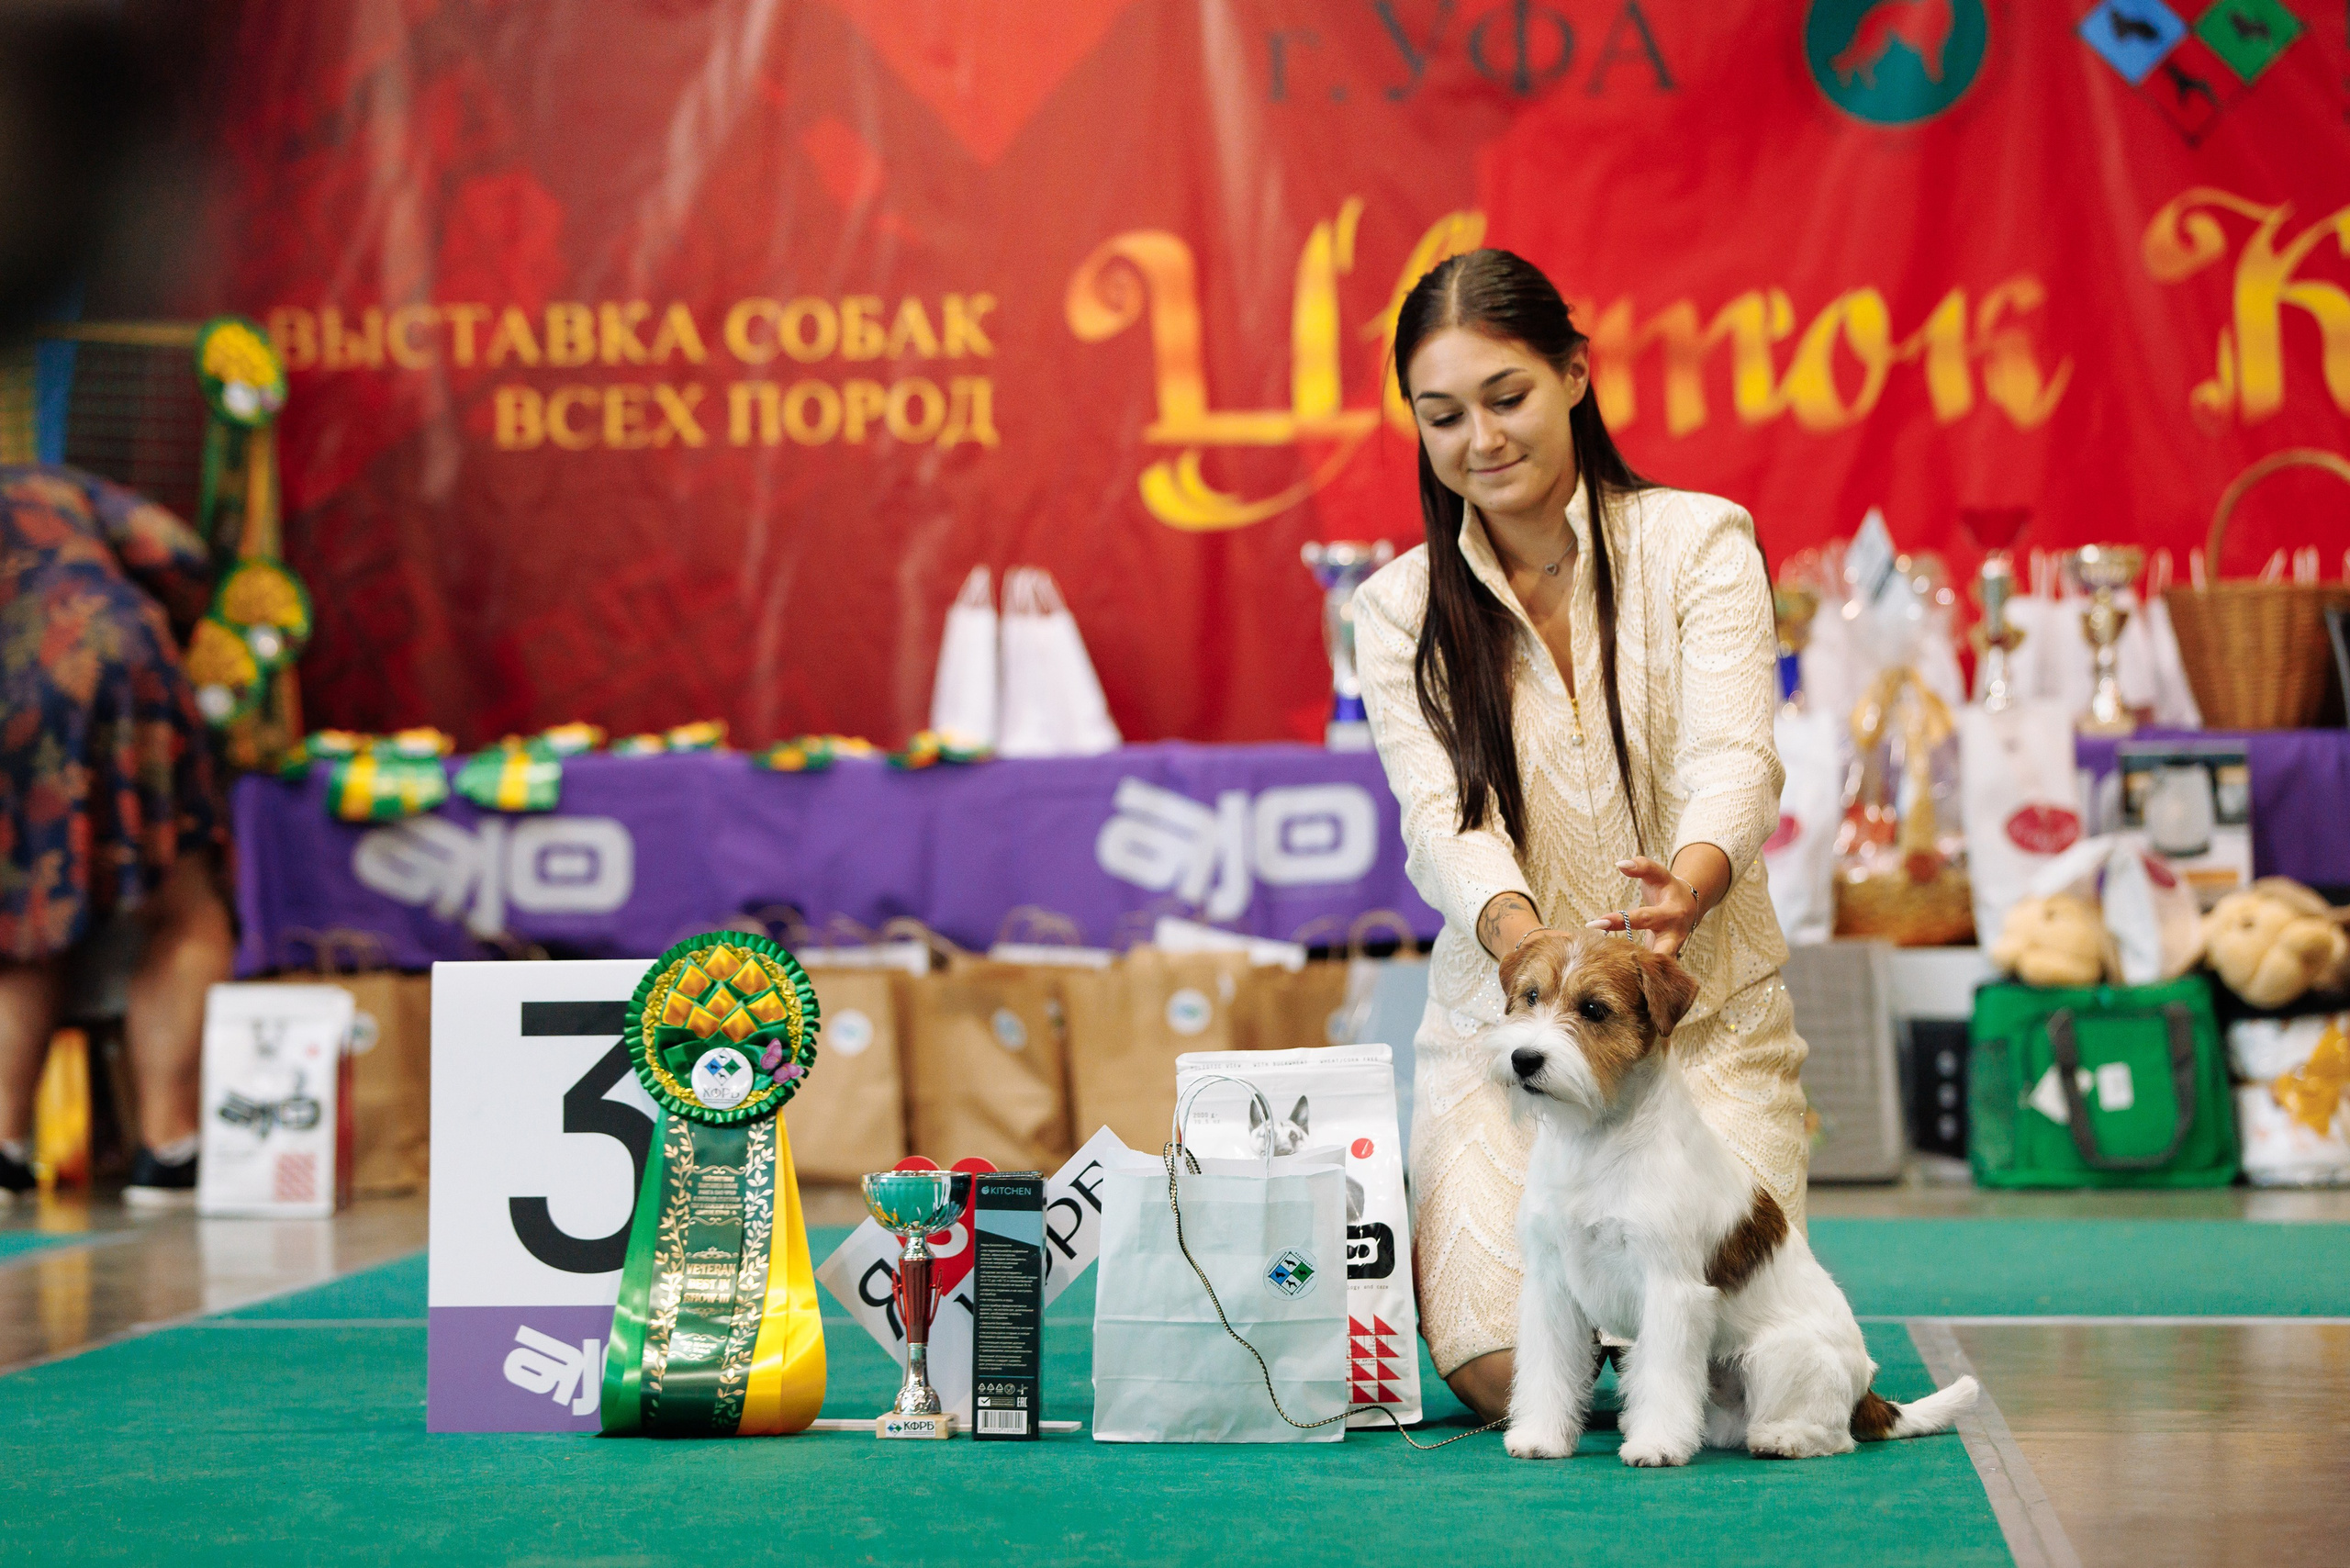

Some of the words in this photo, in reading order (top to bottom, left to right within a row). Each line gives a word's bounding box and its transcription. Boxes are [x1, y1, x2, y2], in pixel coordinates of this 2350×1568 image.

[268, 301, 709, 367] ВЫСТАВКА
[725, 294, 999, 365] СОБАК
[494, 384, 707, 450] ВСЕХ
[728, 376, 1001, 450] ПОРОД
[509, 1002, 655, 1274] 3
[990, 1186, 1032, 1195] KITCHEN
[686, 1263, 736, 1276] VETERAN
[503, 1325, 605, 1416] aj
[903, 1421, 934, 1431] КФРБ
